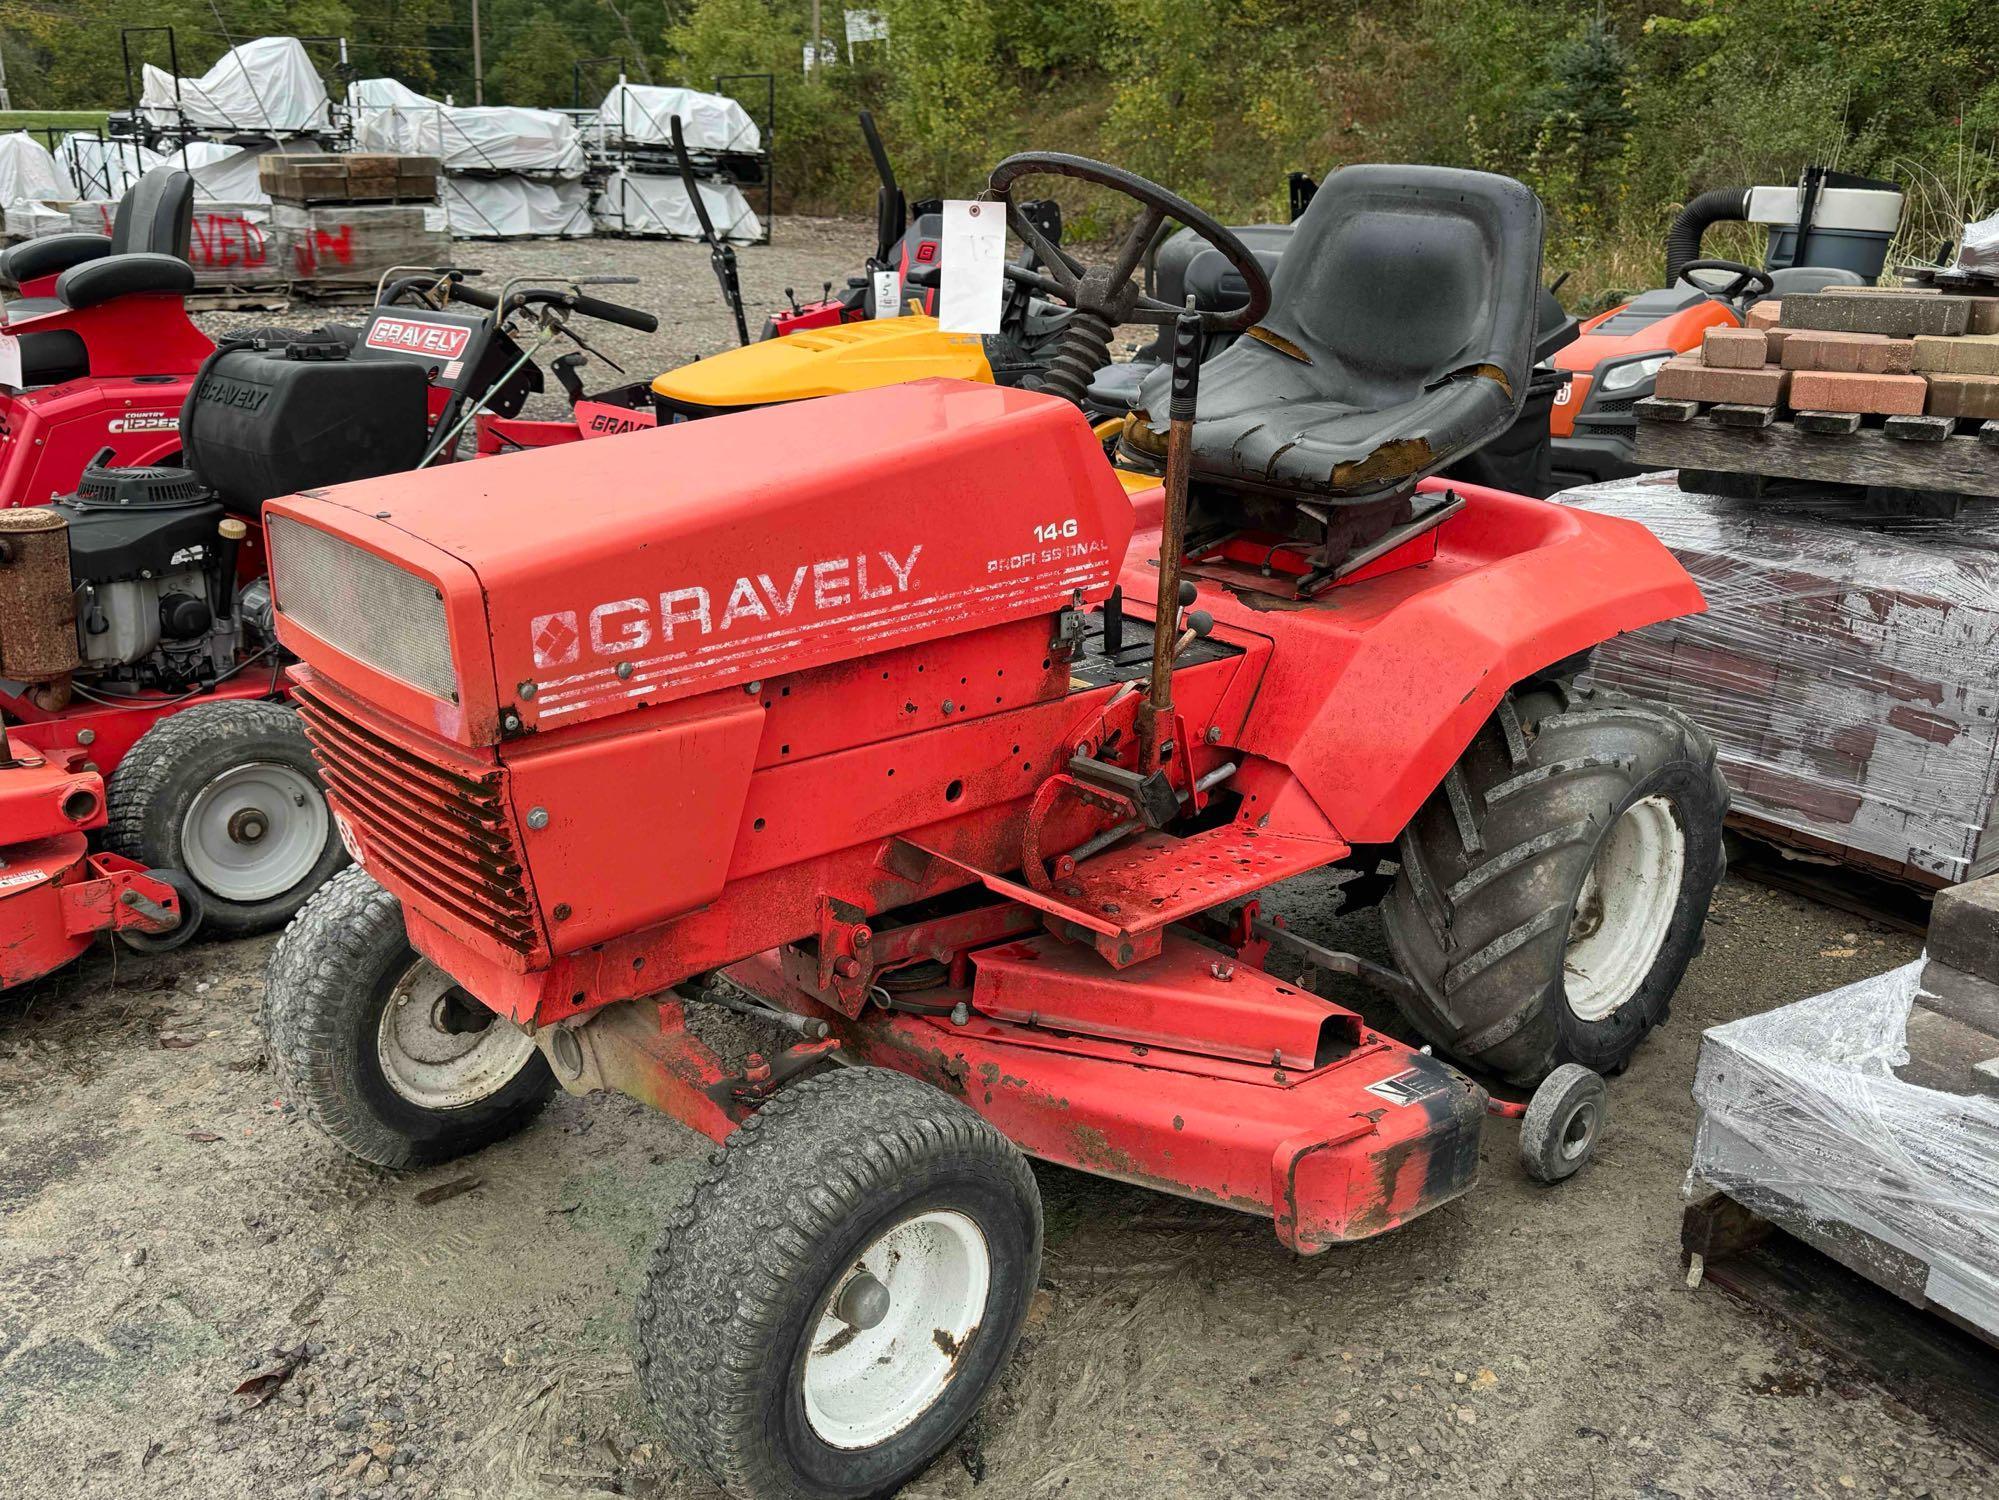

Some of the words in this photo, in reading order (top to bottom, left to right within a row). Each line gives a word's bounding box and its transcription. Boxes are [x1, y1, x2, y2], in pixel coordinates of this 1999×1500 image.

[882, 283, 892, 296] 5
[371, 322, 467, 352] GRAVELY
[199, 382, 268, 410] GRAVELY
[108, 418, 180, 434] CLIPPER
[125, 411, 164, 419] COUNTRY
[589, 544, 923, 656] GRAVELY
